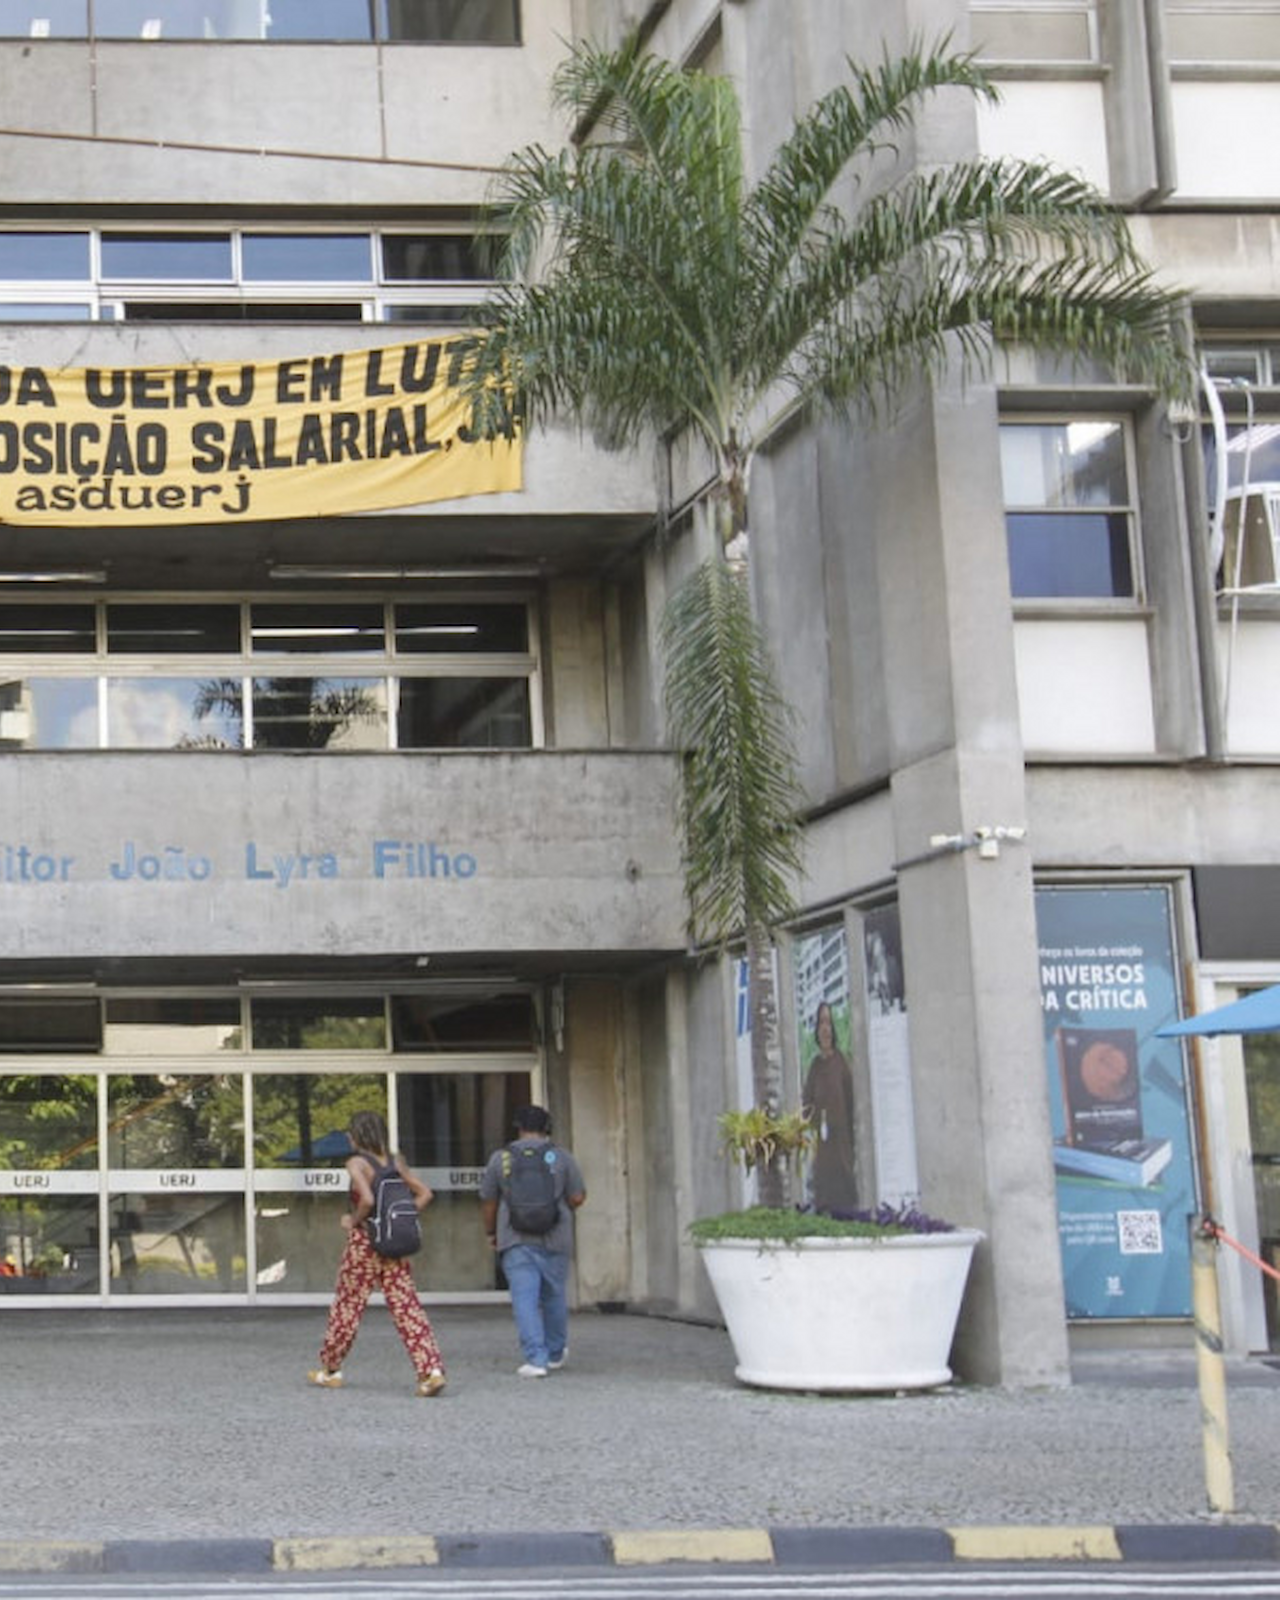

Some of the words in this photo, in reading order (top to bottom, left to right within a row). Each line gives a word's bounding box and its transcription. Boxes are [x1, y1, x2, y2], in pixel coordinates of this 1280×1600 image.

[276, 354, 344, 403] EM
[365, 338, 488, 397] LUT
[15, 474, 252, 514] asduerj
[109, 842, 212, 881] João
[245, 843, 339, 888] Lyra
[373, 841, 477, 879] Filho
[1041, 964, 1145, 986] NIVERSOS
[1040, 990, 1060, 1011] A
[1065, 984, 1148, 1010] CRÍTICA
[14, 1174, 50, 1188] UERJ
[160, 1173, 196, 1187] UERJ
[304, 1172, 340, 1187] UERJ
[450, 1172, 483, 1185] UER
